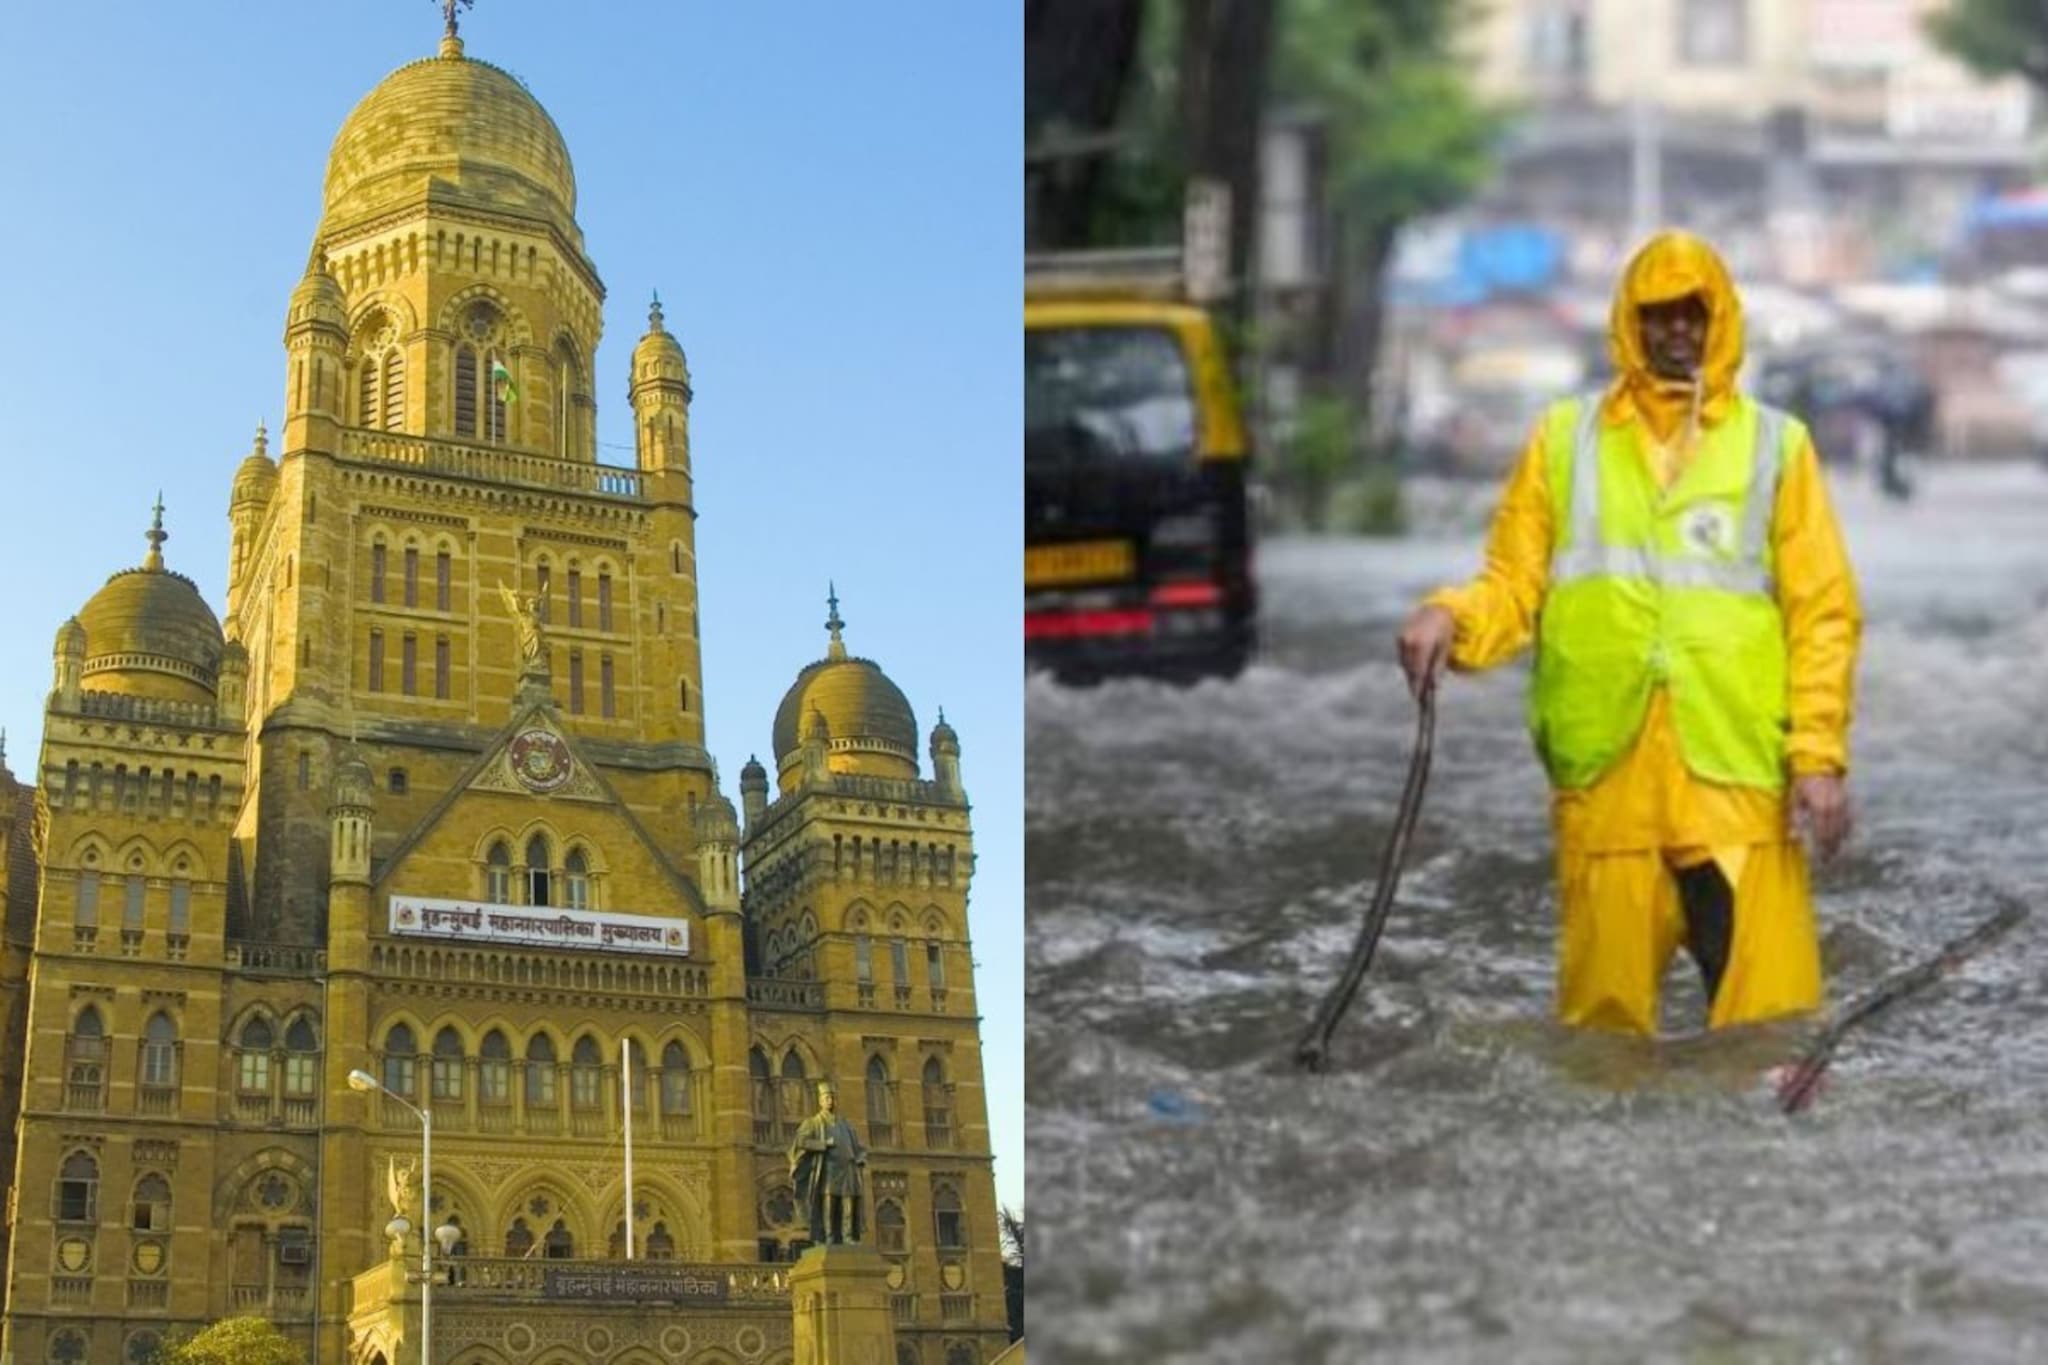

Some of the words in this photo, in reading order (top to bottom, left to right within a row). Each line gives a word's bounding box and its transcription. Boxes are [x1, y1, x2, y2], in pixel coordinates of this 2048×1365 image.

[422, 906, 482, 932] बृहन्मुंबई
[488, 914, 596, 937] महानगरपालिका
[601, 922, 662, 944] मुख्यालय
